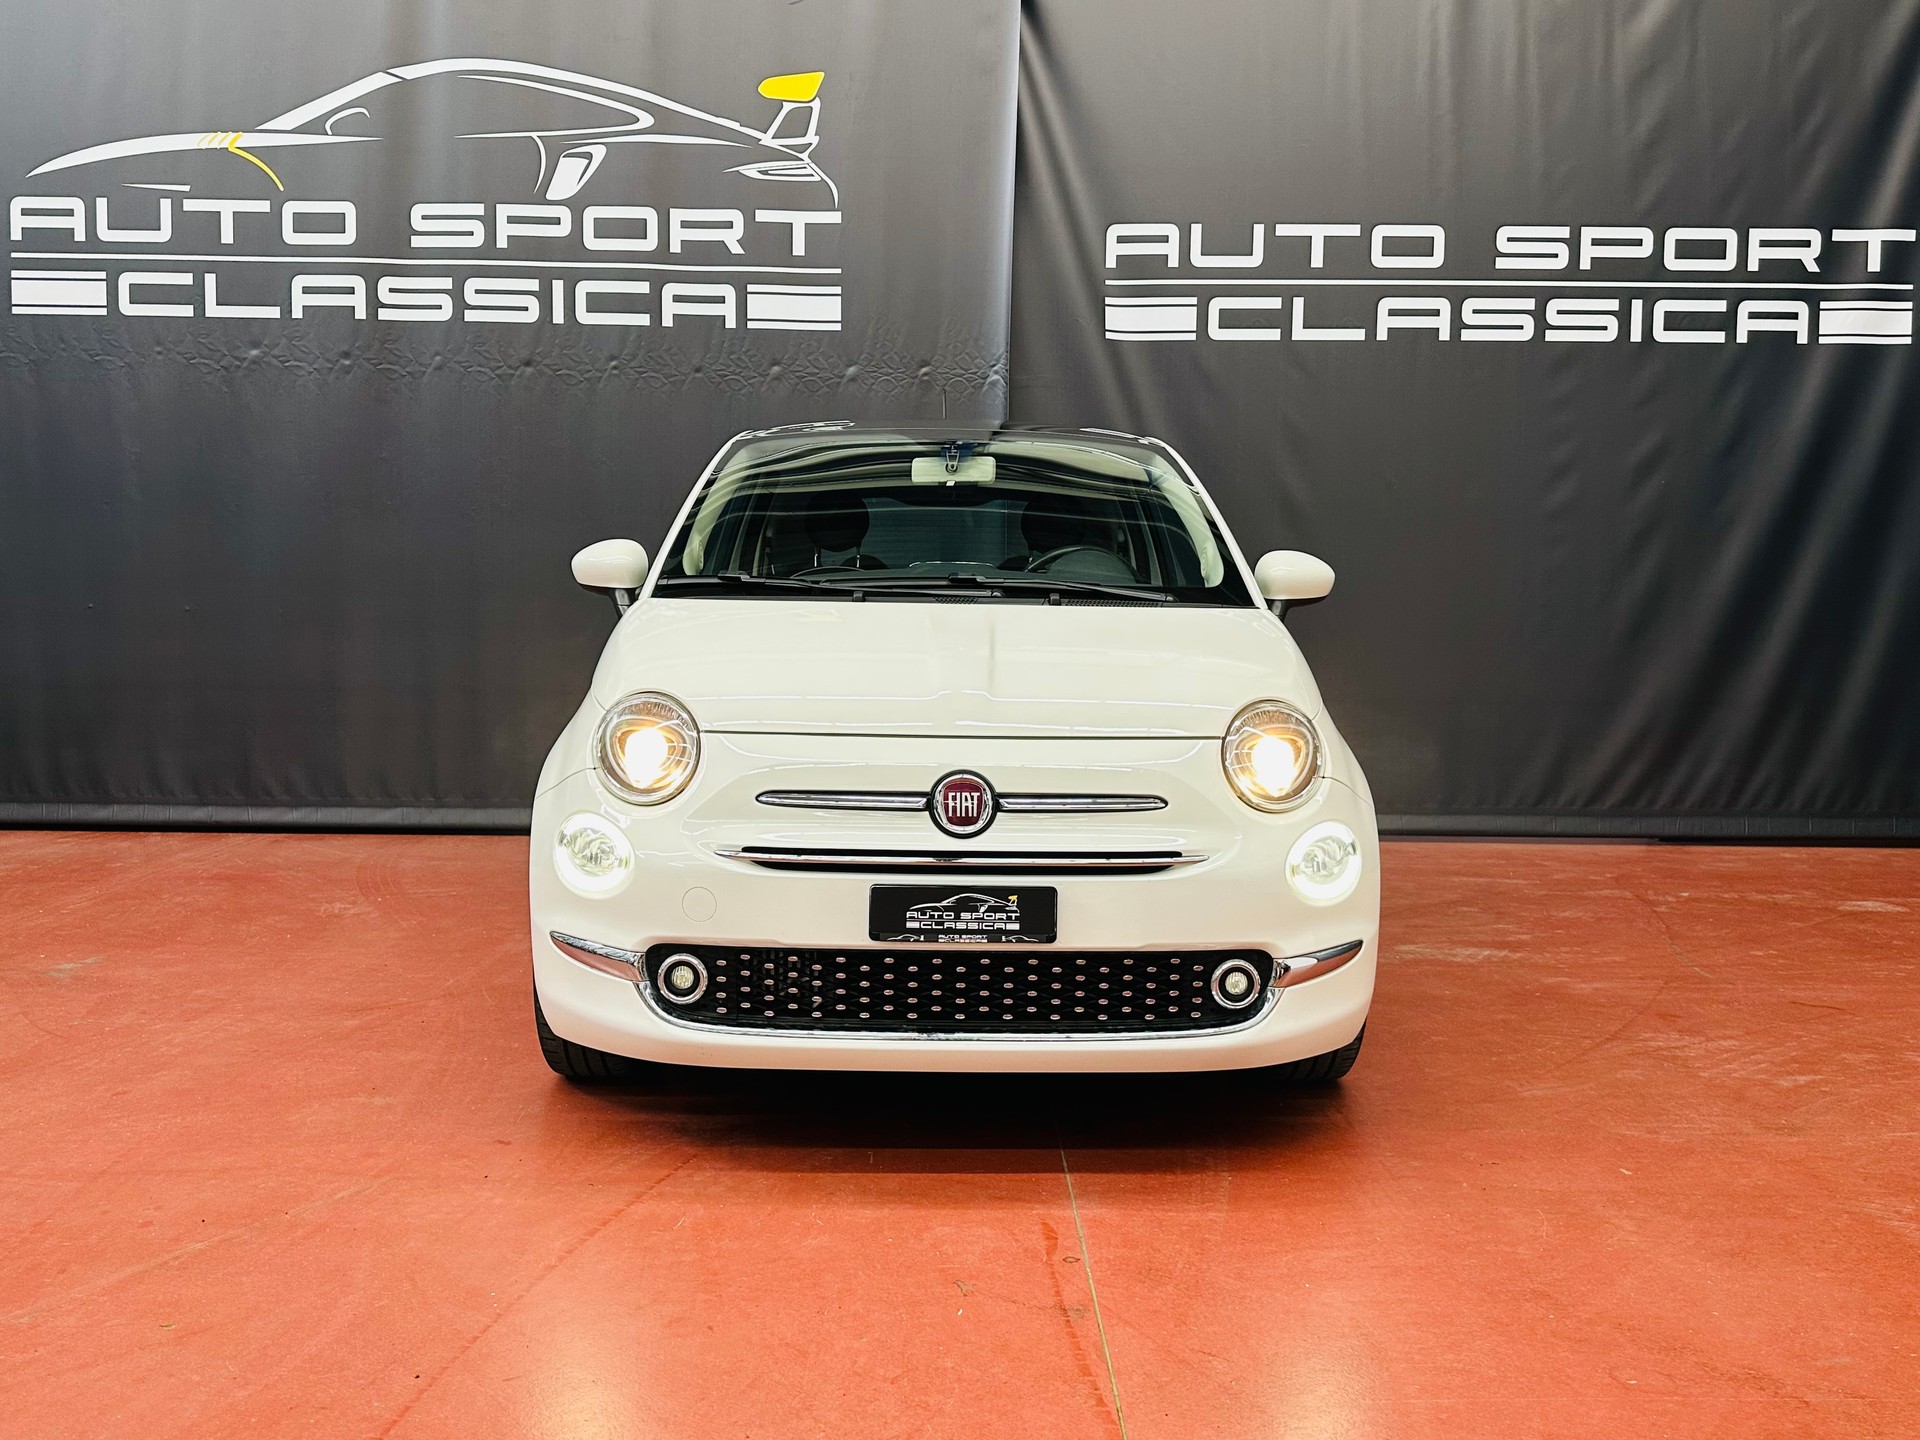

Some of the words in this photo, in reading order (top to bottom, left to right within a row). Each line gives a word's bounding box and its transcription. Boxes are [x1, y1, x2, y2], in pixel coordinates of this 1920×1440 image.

[9, 196, 358, 246] AUTO
[410, 202, 843, 257] SPORT
[1105, 223, 1446, 269] AUTO
[1495, 226, 1918, 273] SPORT
[117, 270, 737, 330] CLASSICA
[1207, 296, 1809, 345] CLASSICA
[948, 792, 980, 817] FIAT
[906, 912, 955, 920] AUTO
[960, 912, 1020, 921] SPORT
[920, 921, 1006, 930] CLASSICA
